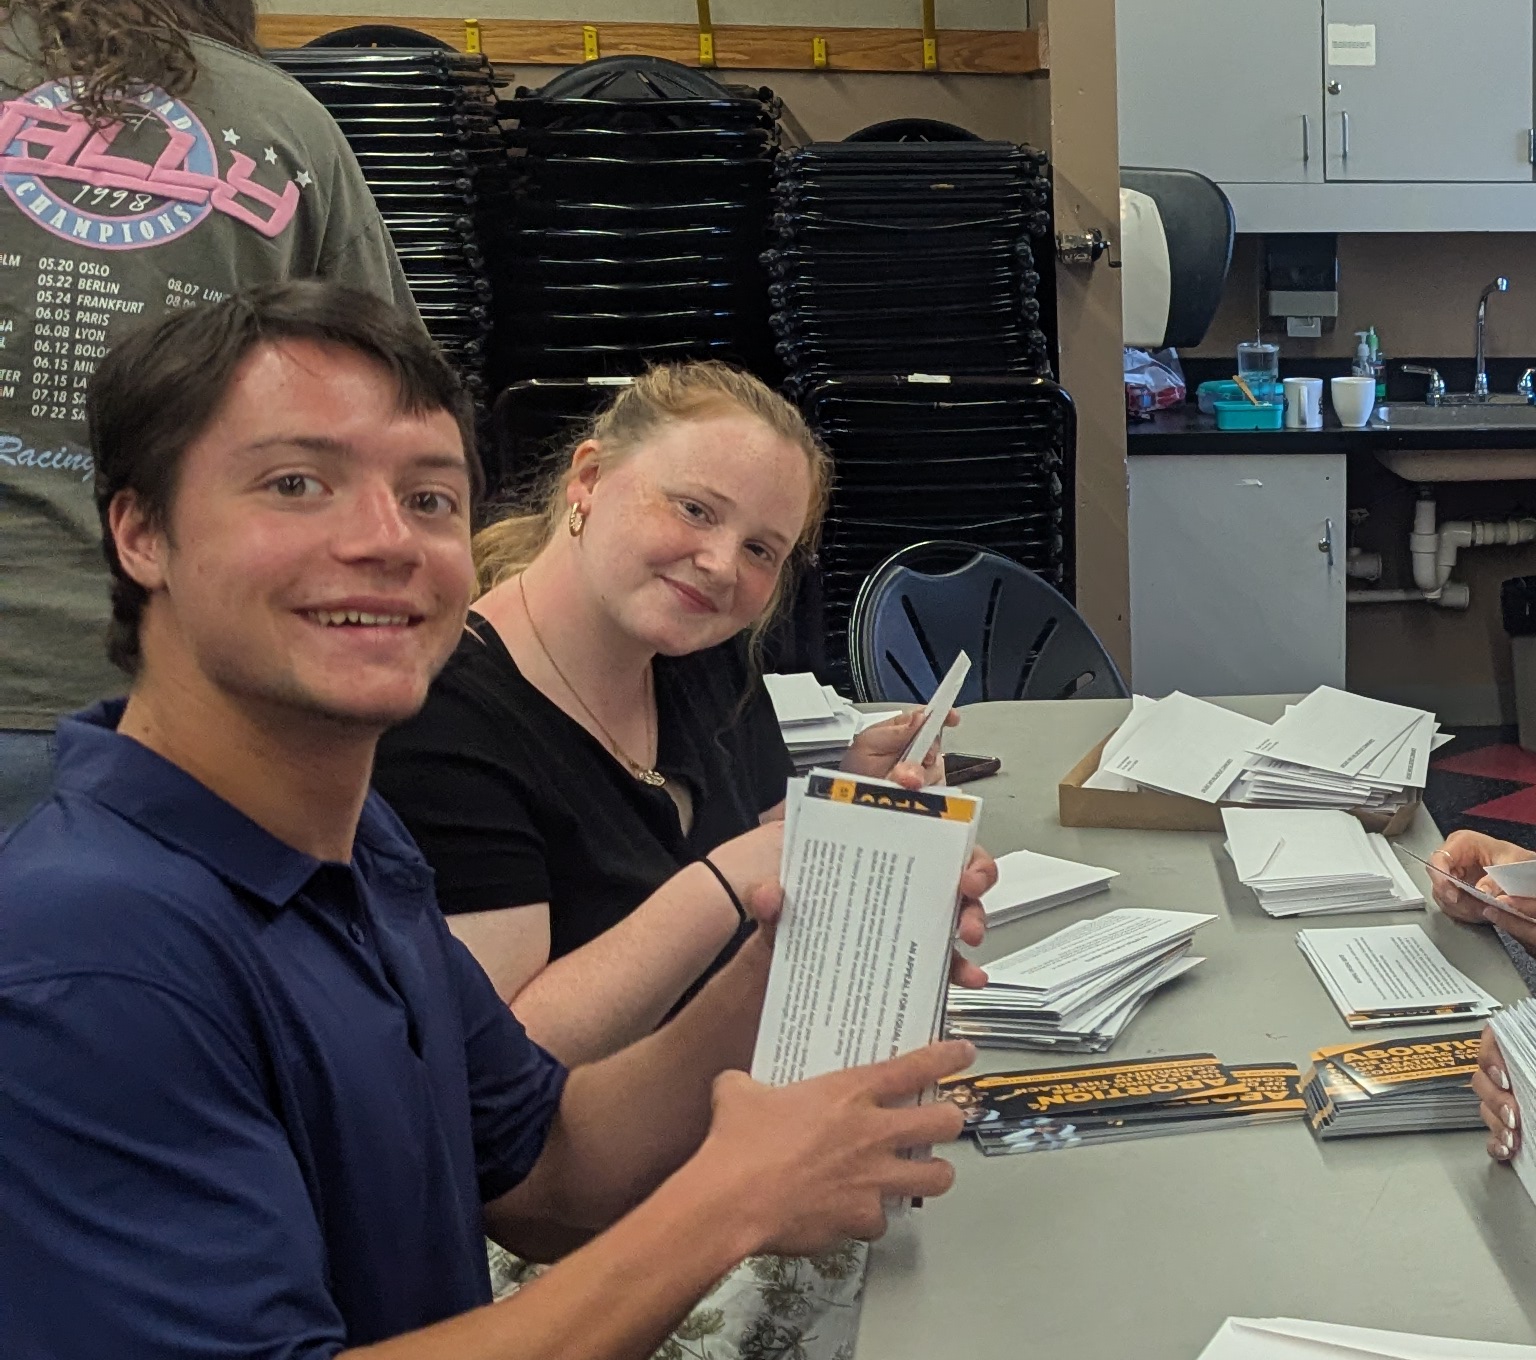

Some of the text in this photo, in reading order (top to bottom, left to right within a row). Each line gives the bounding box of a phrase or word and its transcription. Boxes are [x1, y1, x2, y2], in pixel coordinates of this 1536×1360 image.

[72, 184, 153, 212] 1998
[15, 181, 193, 243] CHAMPIONS
[38, 257, 110, 278] 05.20 OSLO
[37, 273, 120, 295] 05.22 BERLIN
[168, 278, 199, 296] 08.07
[36, 290, 145, 314] 05.24 FRANKFURT
[35, 307, 110, 326] 06.05 PARIS
[34, 323, 106, 342] 06.08 LYON
[34, 339, 69, 355] 06.12
[33, 356, 97, 374] 06.15 MIL
[32, 373, 67, 387] 07.15
[32, 389, 67, 403] 07.18
[1384, 1050, 1453, 1064] LEADING
[1036, 1077, 1228, 1106] ABORTION
